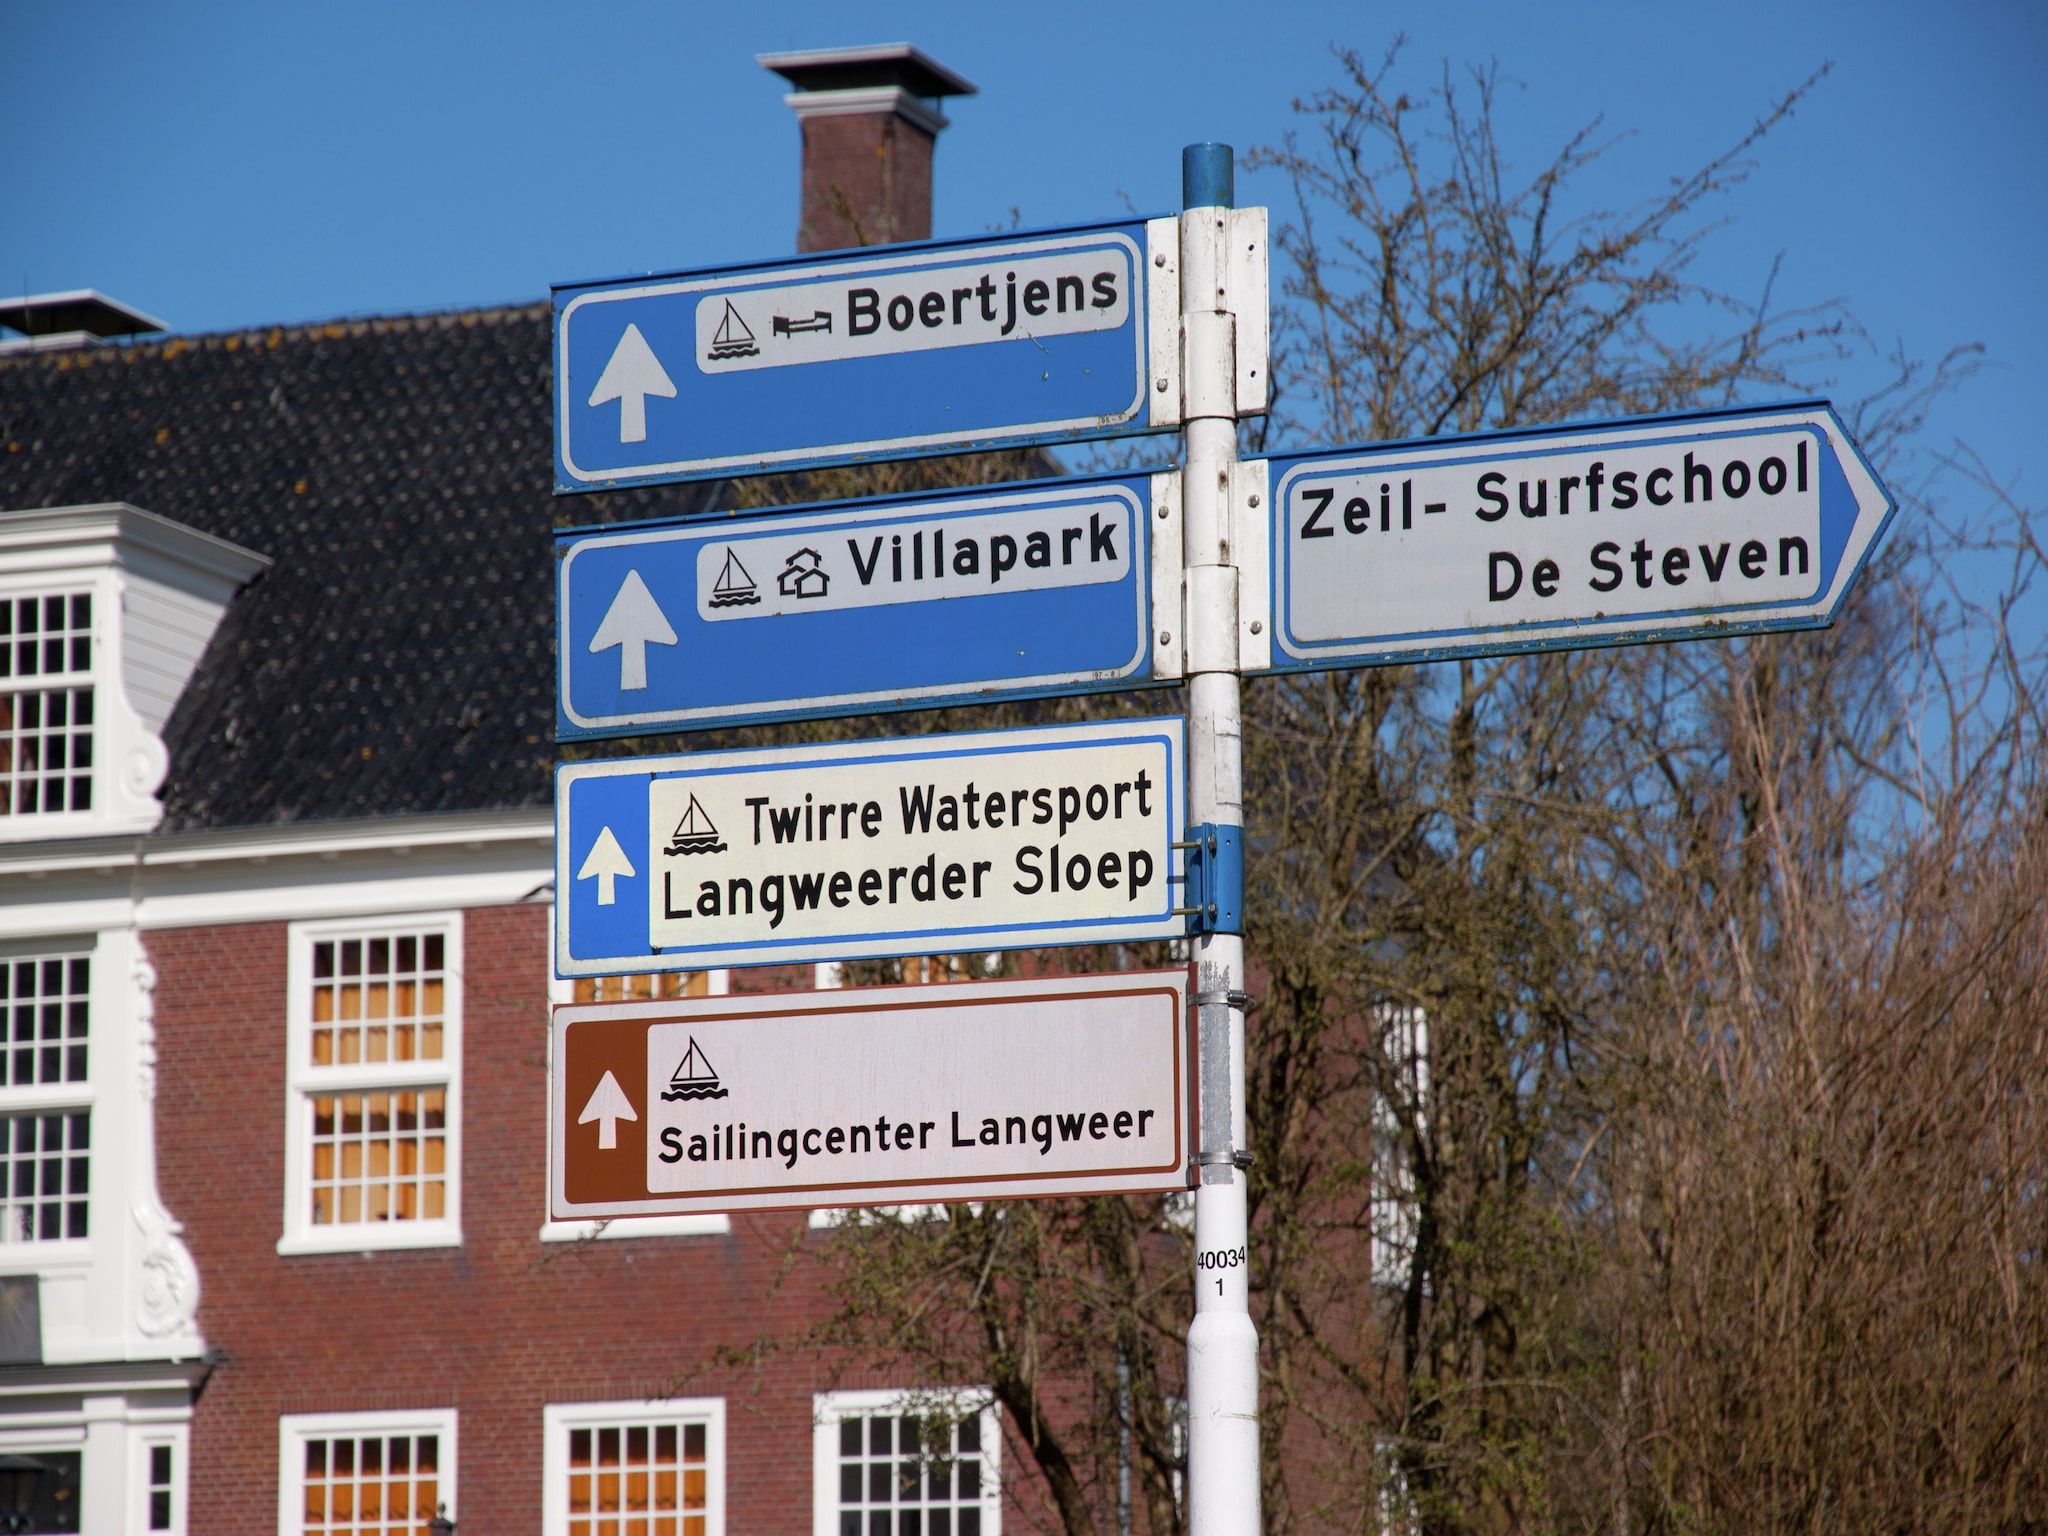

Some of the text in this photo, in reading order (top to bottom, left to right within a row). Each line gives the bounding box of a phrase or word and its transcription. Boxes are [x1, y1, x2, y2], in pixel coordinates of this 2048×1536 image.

[848, 271, 1118, 337] Boertjens
[1300, 439, 1808, 540] Zeil- Surfschool
[847, 512, 1118, 586] Villapark
[1488, 536, 1809, 602] De Steven
[744, 768, 1152, 846] Twirre Watersport
[663, 843, 1154, 929] Langweerder Sloep
[658, 1109, 1155, 1170] Sailingcenter Langweer
[1197, 1245, 1246, 1270] 40034
[1215, 1278, 1223, 1296] 1
